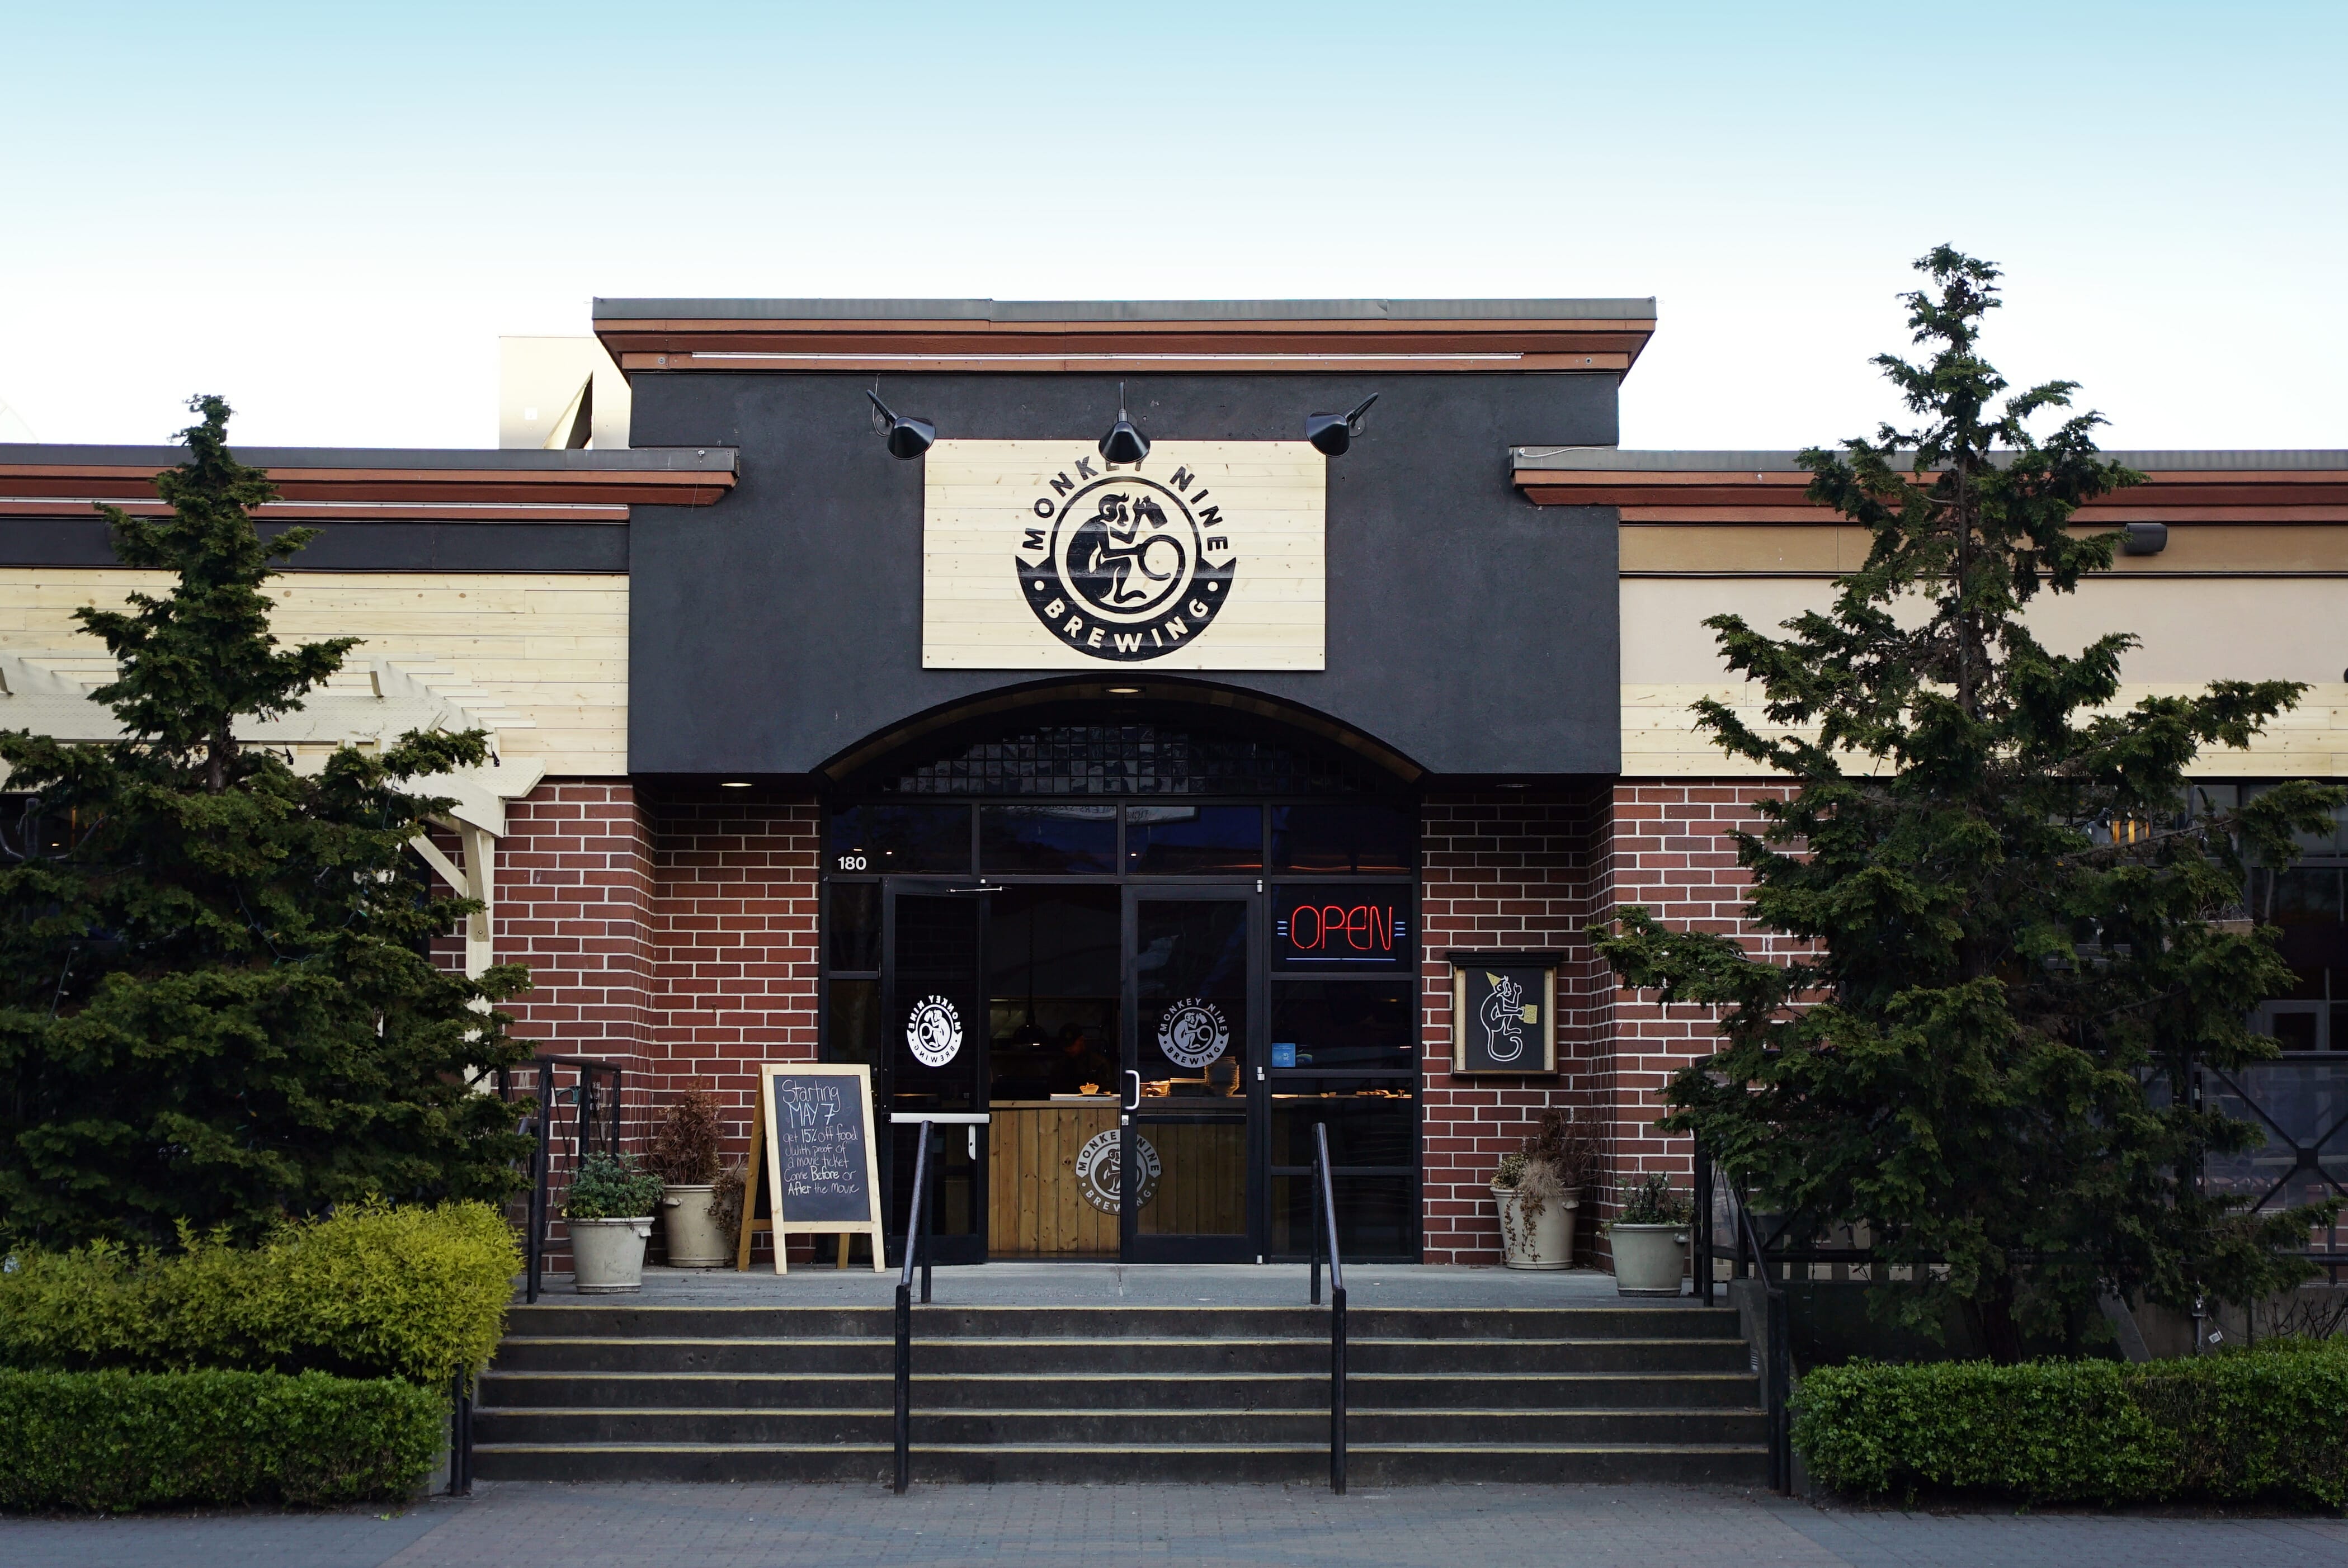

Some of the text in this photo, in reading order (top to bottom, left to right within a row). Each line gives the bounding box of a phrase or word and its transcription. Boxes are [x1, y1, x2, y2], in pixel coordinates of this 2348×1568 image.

[1170, 466, 1229, 551] NINE
[1044, 598, 1208, 653] BREWING
[838, 856, 866, 870] 180
[1291, 905, 1392, 950] OPEN
[1160, 998, 1227, 1032] MONKEY NINE
[1167, 1046, 1220, 1065] BREWING
[782, 1079, 840, 1112] Starting
[788, 1101, 835, 1128] MAY 7
[783, 1130, 798, 1156] get
[801, 1128, 817, 1143] 15%
[818, 1126, 833, 1142] off
[792, 1141, 847, 1156] with proof of
[1078, 1131, 1159, 1172] MONKE NINE
[784, 1165, 856, 1182] Come Before or
[788, 1154, 849, 1169] a movie ticket
[788, 1181, 812, 1196] After
[814, 1183, 828, 1194] the
[1086, 1189, 1151, 1212] BREWNG
